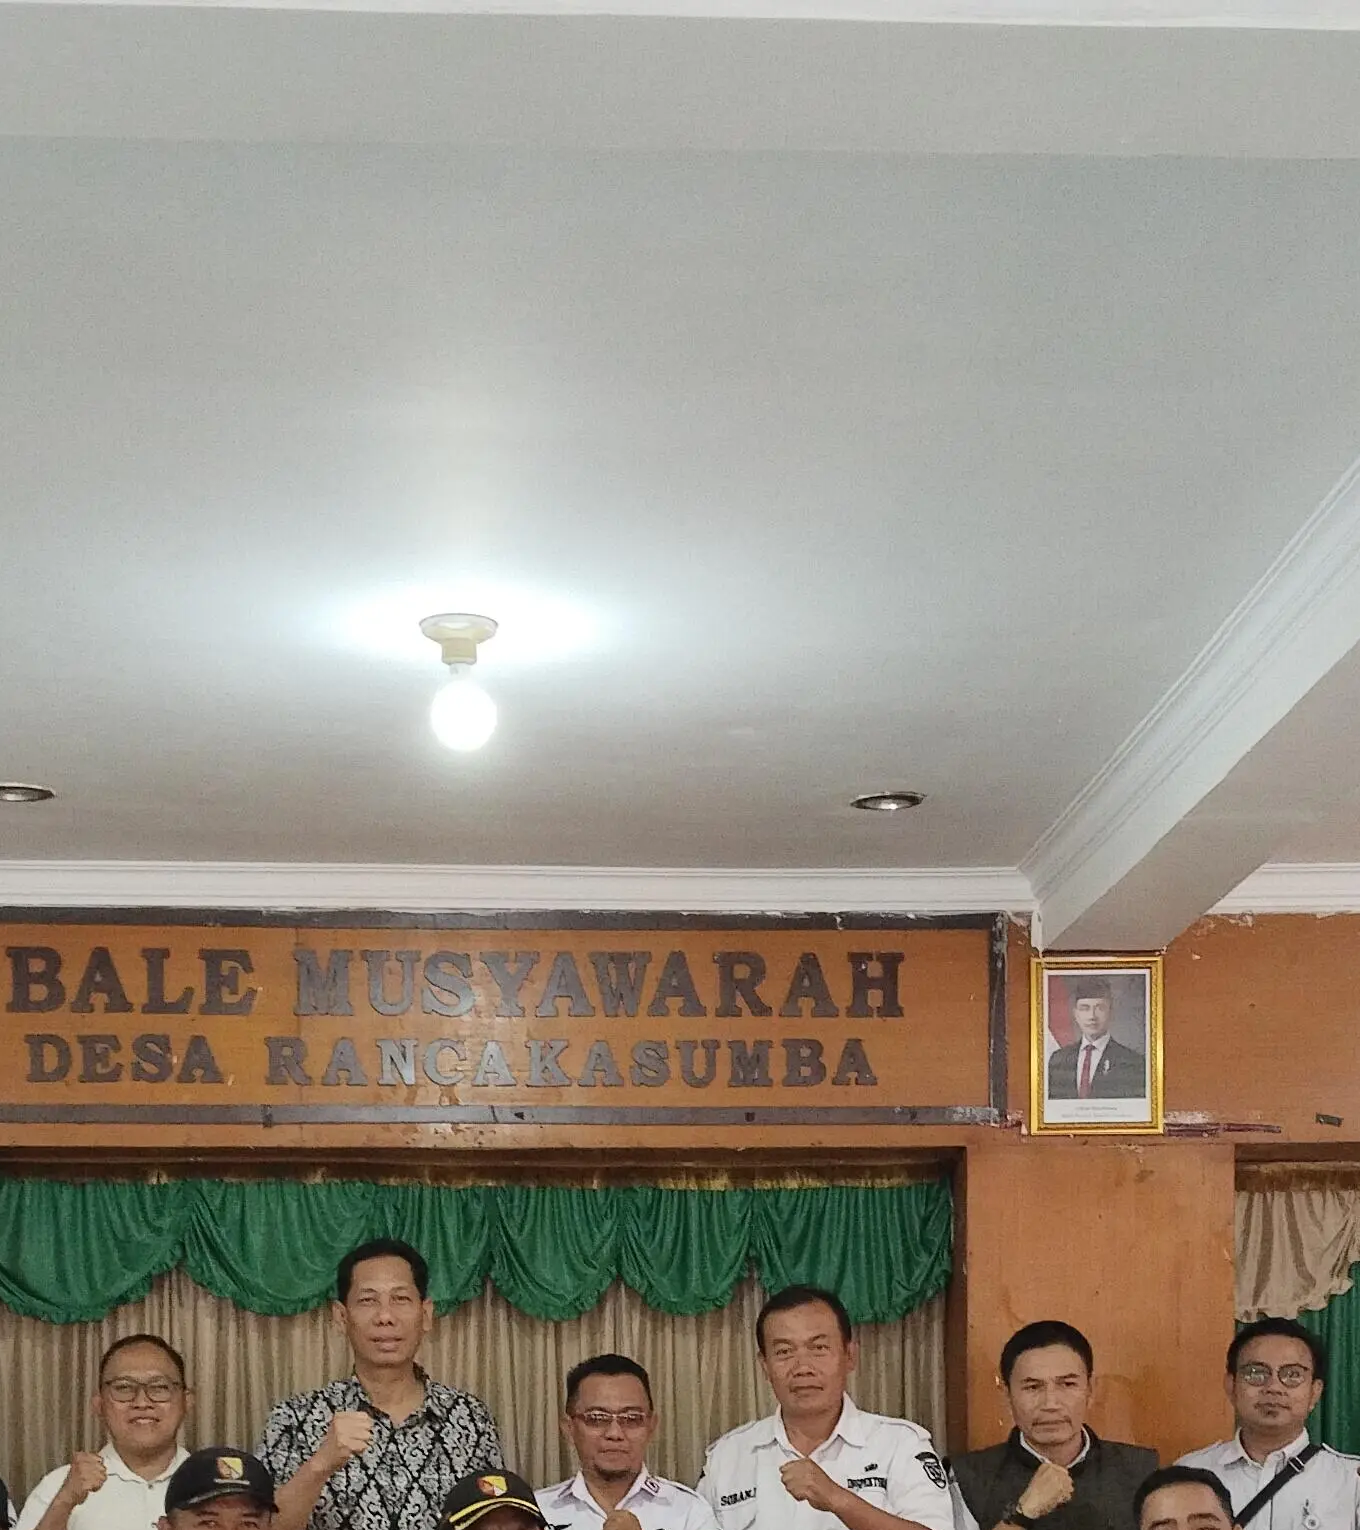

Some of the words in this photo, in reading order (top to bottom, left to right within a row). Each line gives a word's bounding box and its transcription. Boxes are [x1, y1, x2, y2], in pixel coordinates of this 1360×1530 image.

[5, 945, 257, 1017] BALE
[292, 948, 906, 1018] MUSYAWARAH
[23, 1033, 225, 1084] DESA
[263, 1036, 878, 1087] RANCAKASUMBA
